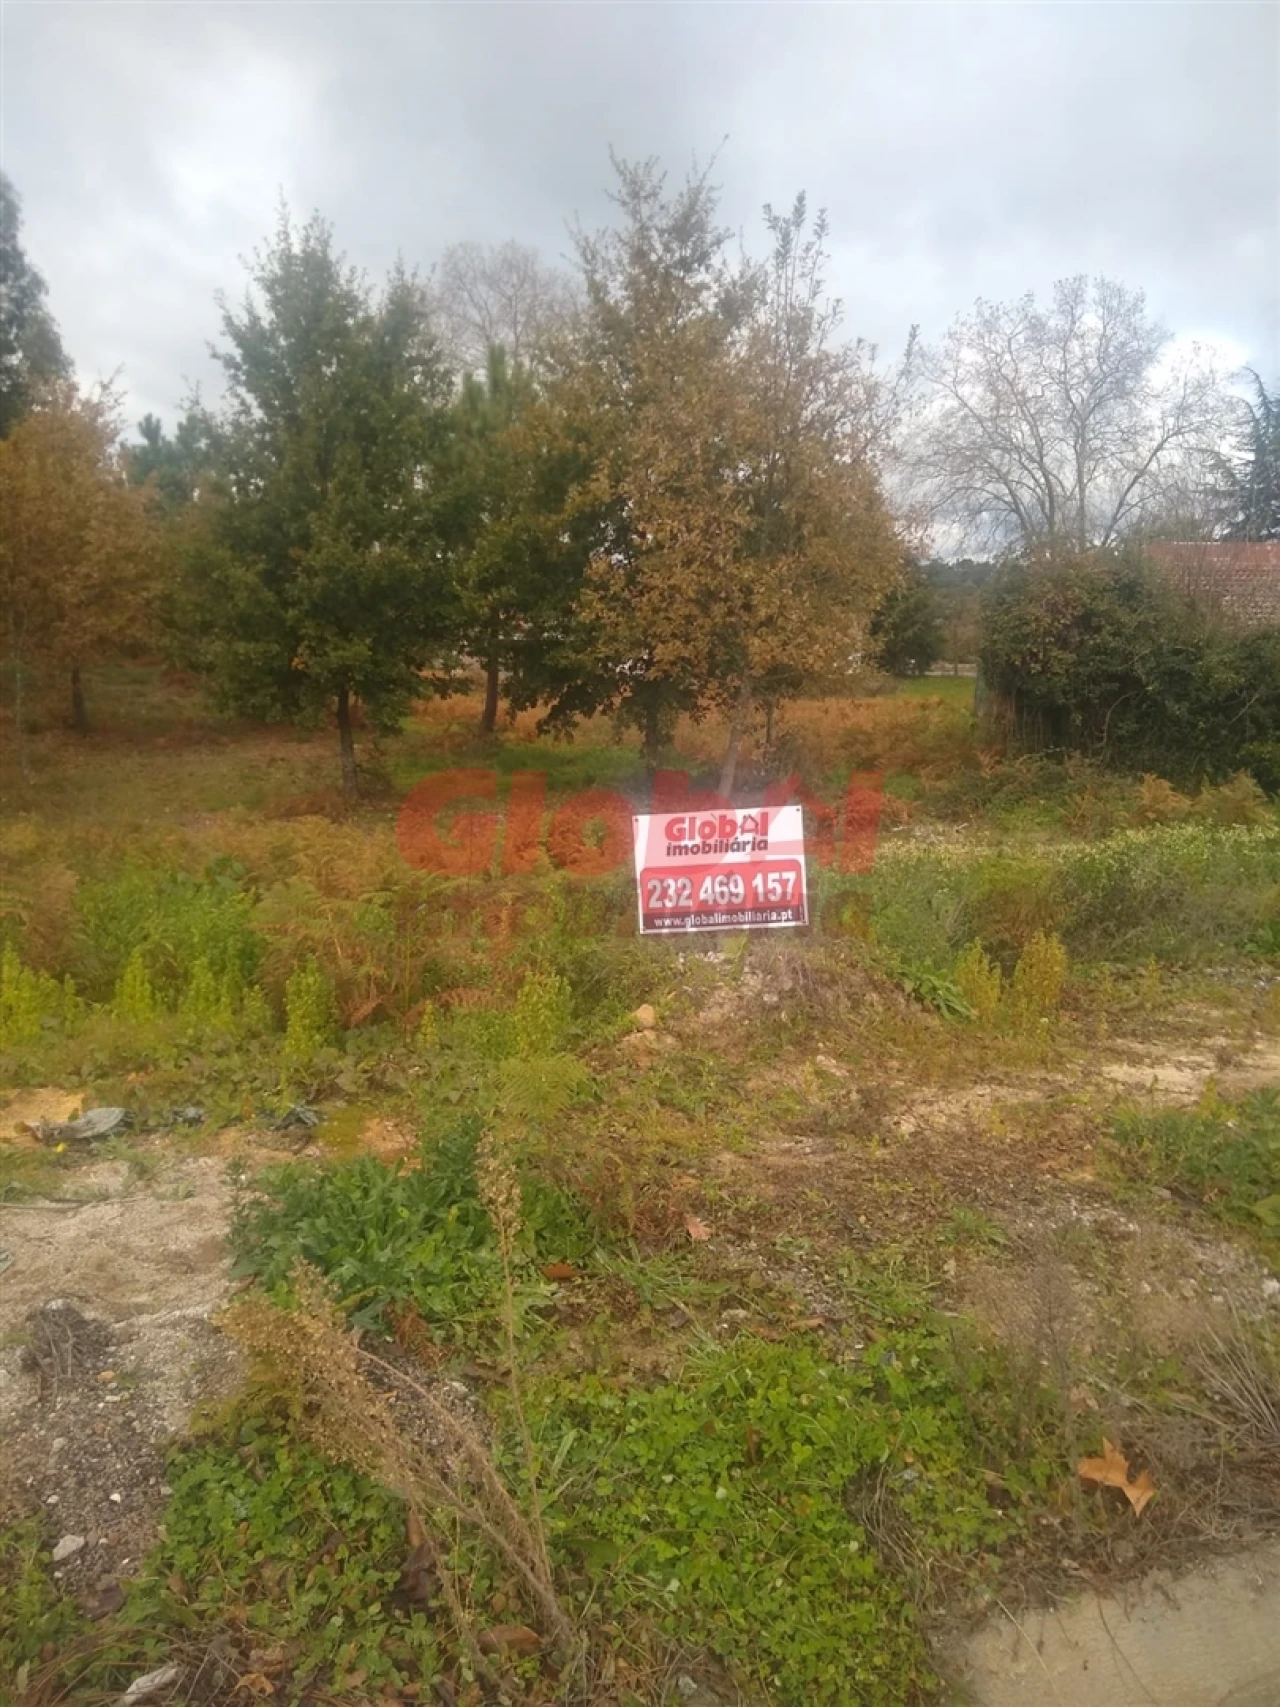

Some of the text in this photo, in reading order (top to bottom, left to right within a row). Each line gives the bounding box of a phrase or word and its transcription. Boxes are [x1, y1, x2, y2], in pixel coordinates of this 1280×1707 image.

[665, 812, 769, 841] Global
[666, 836, 768, 856] imobiliária
[647, 871, 797, 908] 232 469 157
